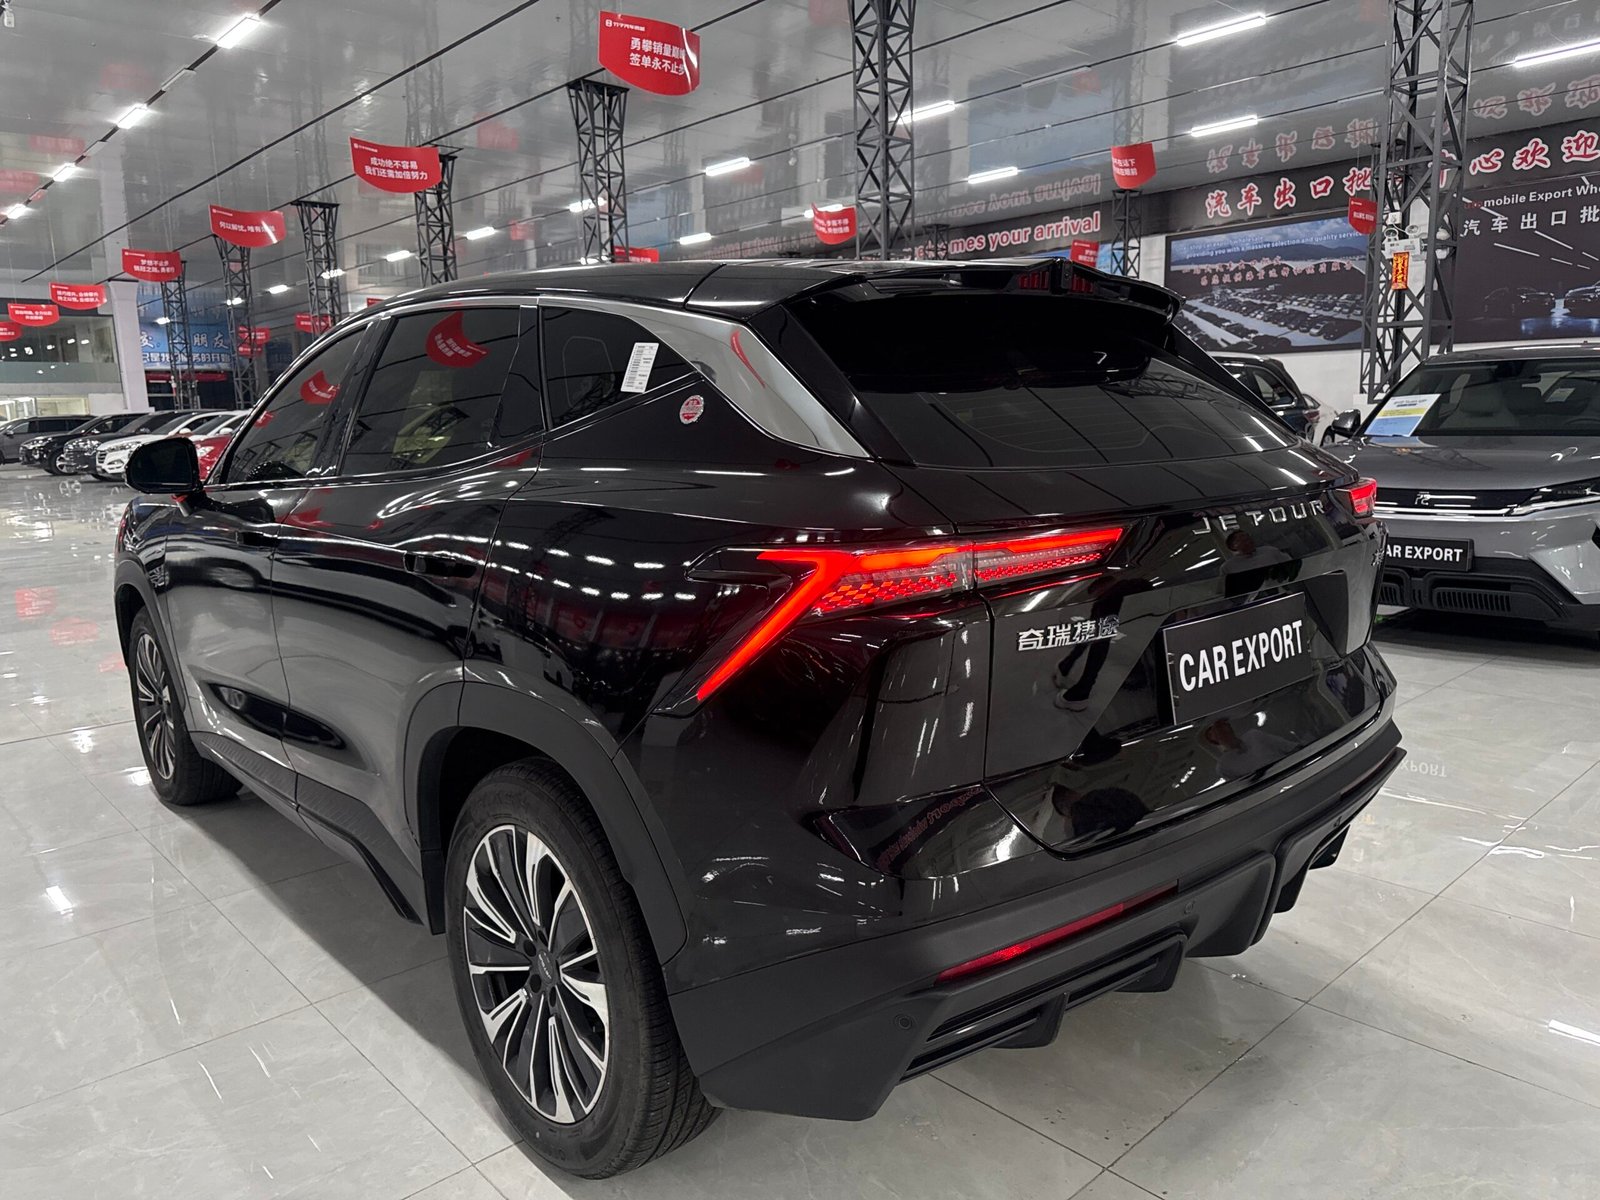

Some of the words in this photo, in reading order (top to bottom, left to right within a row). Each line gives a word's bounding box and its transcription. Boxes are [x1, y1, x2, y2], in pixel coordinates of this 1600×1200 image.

[364, 165, 428, 180] 我们还需加倍努力
[370, 157, 418, 170] 成功绝不容易
[1529, 190, 1573, 206] Export
[988, 227, 1031, 250] your
[1034, 210, 1101, 240] arrival
[1460, 204, 1600, 237] 汽车出口批
[1227, 246, 1240, 254] with
[1314, 233, 1338, 243] quality
[1192, 500, 1325, 535] JETOUR
[1405, 546, 1463, 562] EXPORT
[1018, 614, 1120, 652] 奇瑞捷途
[1178, 643, 1229, 692] CAR
[1231, 619, 1304, 684] EXPORT
